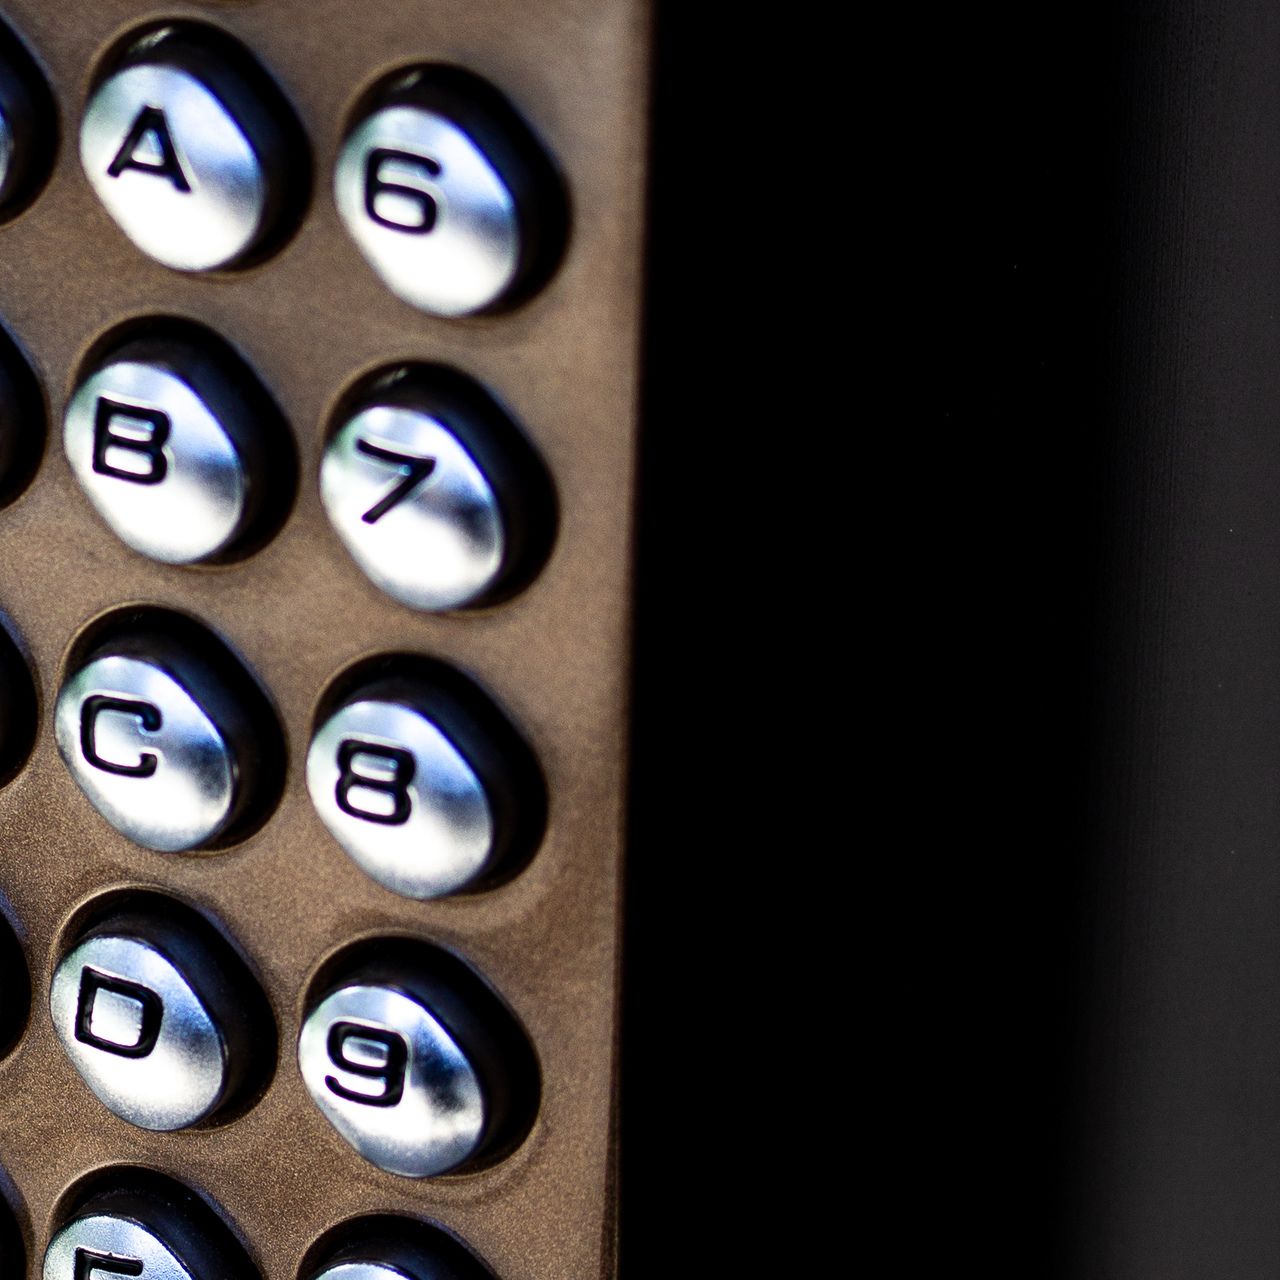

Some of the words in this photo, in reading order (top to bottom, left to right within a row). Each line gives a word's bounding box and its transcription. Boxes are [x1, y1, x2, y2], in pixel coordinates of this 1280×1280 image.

[106, 104, 193, 194] A
[363, 146, 442, 235] 6
[92, 394, 172, 487] B
[355, 437, 437, 526] 7
[79, 693, 163, 779] C
[334, 738, 417, 827] 8
[74, 965, 164, 1060] D
[324, 1019, 411, 1109] 9
